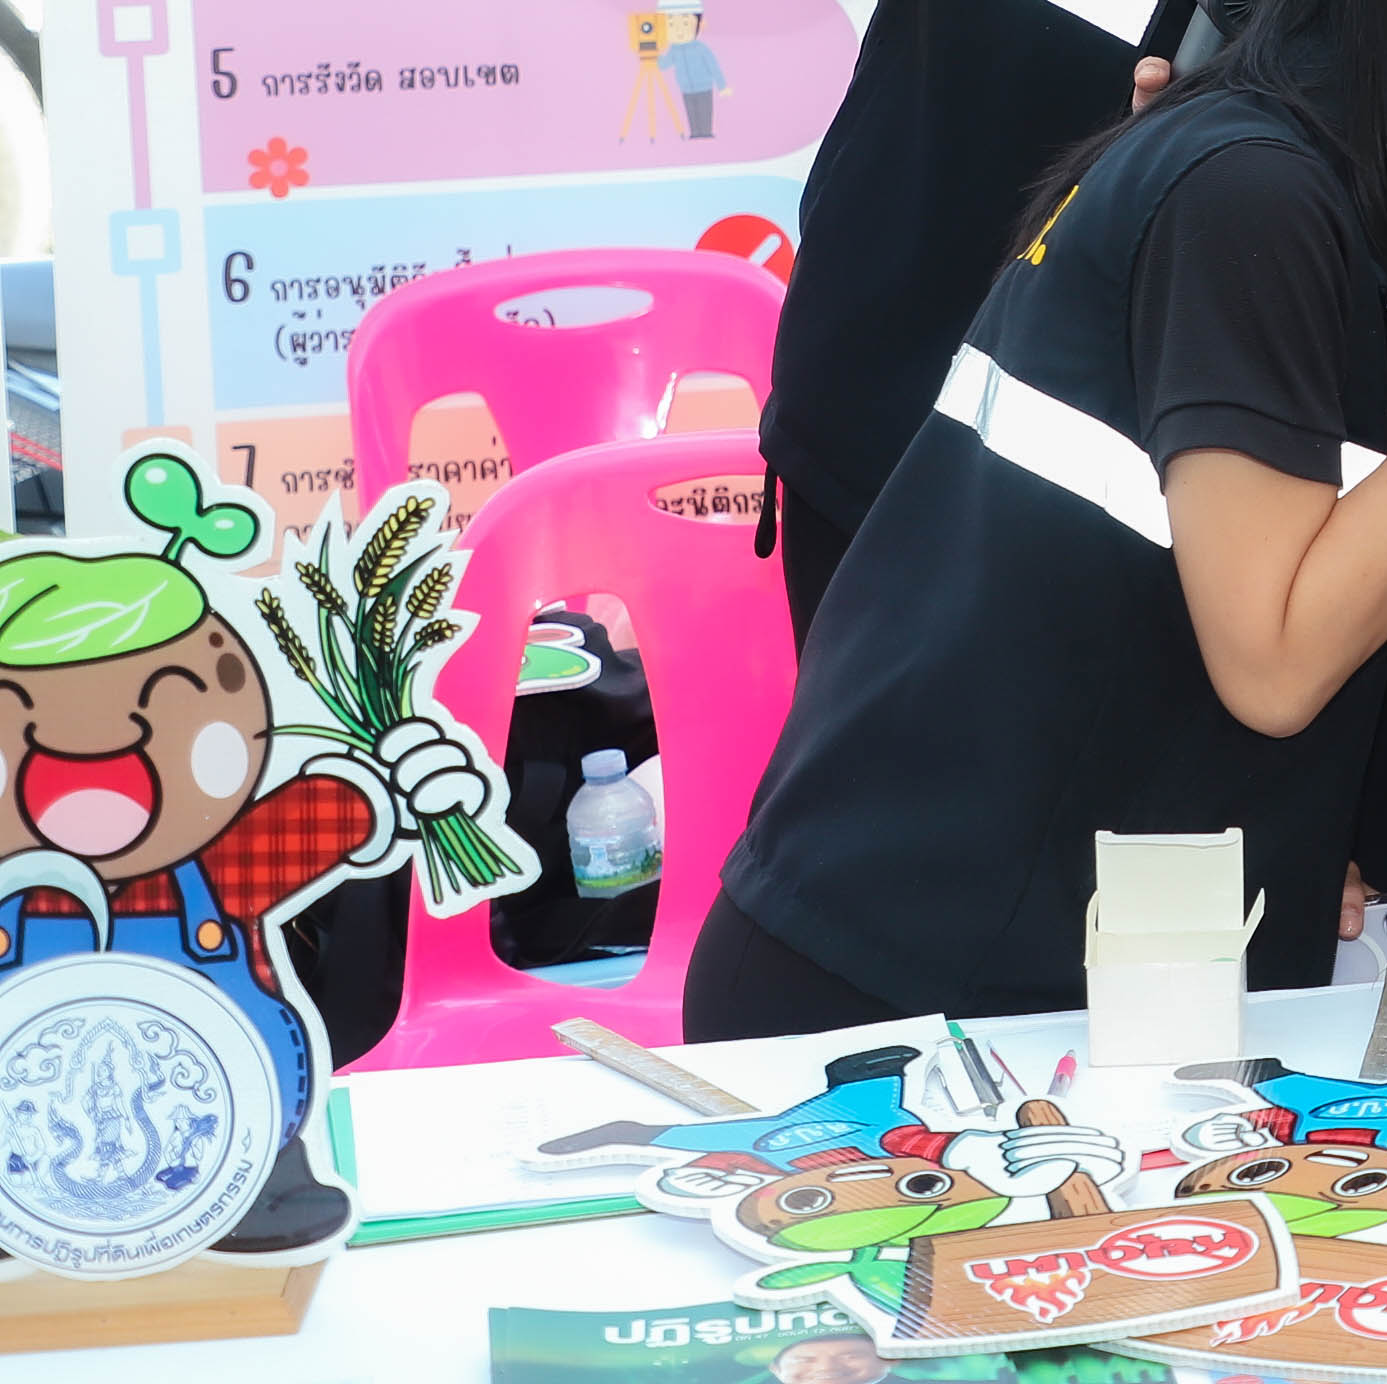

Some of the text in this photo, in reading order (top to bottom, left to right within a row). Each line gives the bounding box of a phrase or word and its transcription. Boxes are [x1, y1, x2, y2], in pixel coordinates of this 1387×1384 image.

[211, 46, 521, 101] 5 การรังวัด สอบเขต
[223, 251, 255, 303] 6
[275, 307, 355, 368] (ผู้ว่าร
[231, 444, 256, 489] 7
